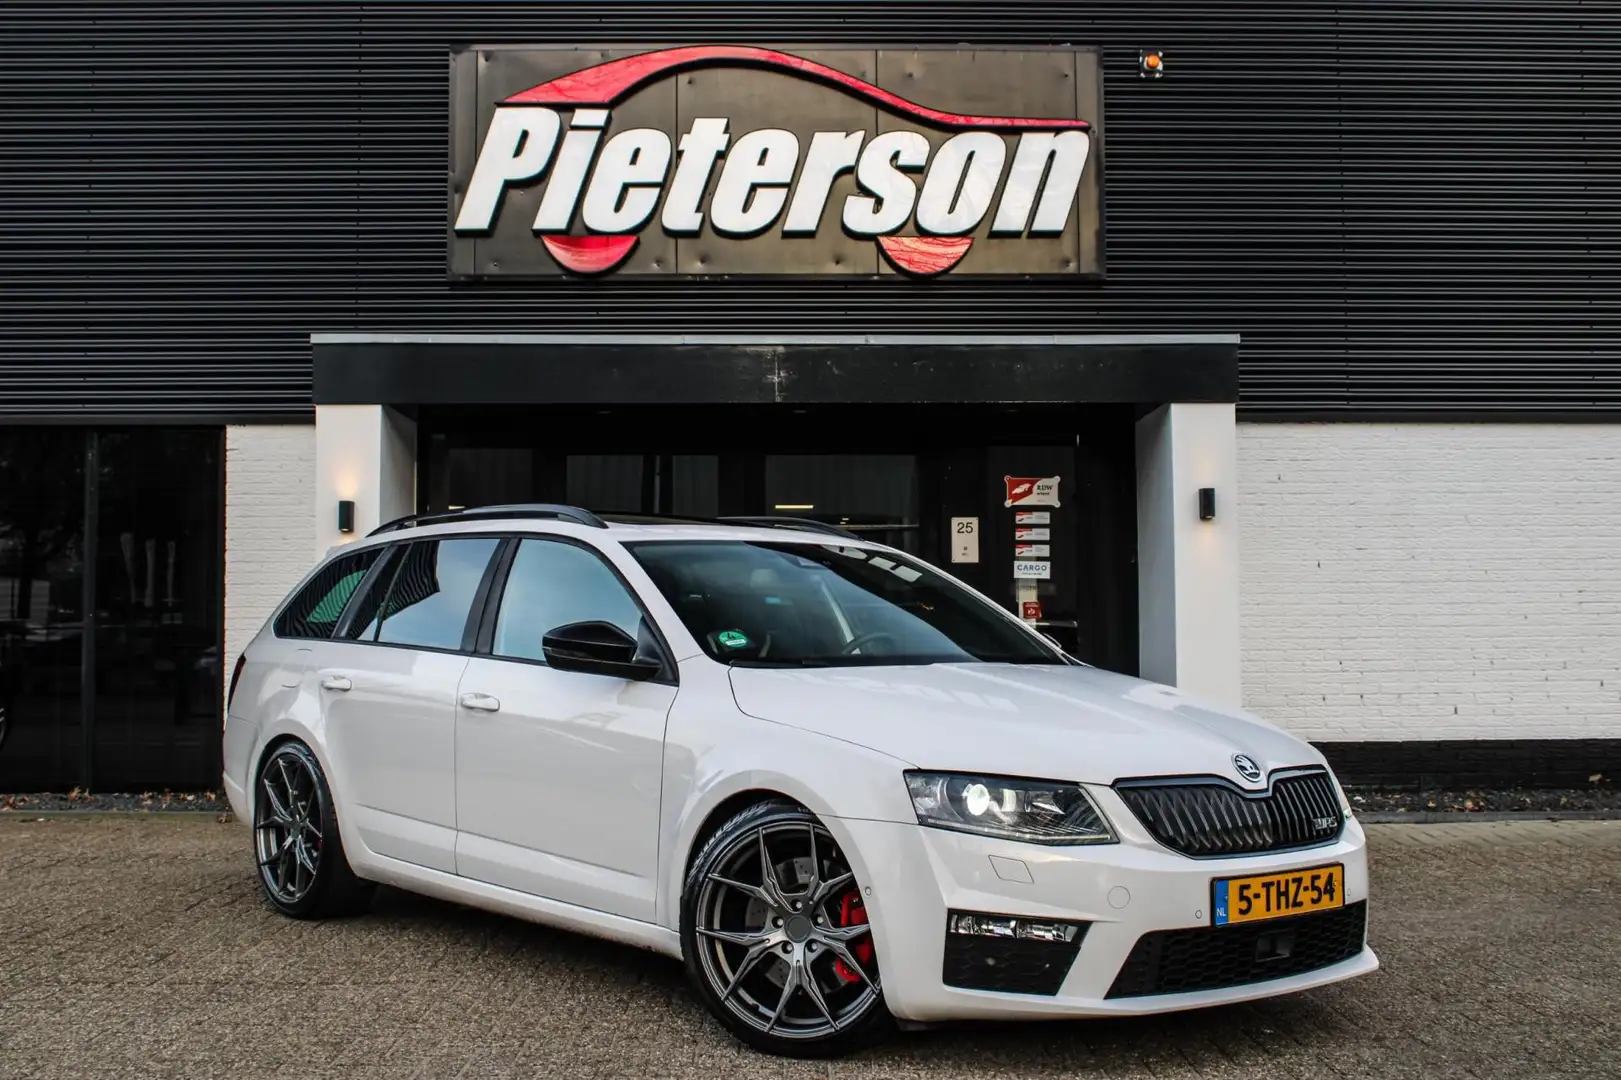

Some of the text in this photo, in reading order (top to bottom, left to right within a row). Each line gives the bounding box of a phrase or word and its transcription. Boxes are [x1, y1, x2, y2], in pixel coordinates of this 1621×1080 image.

[453, 107, 1089, 236] Pieterson
[957, 522, 974, 534] 25
[1238, 872, 1335, 915] 5-THZ-54
[1216, 907, 1226, 917] NL
